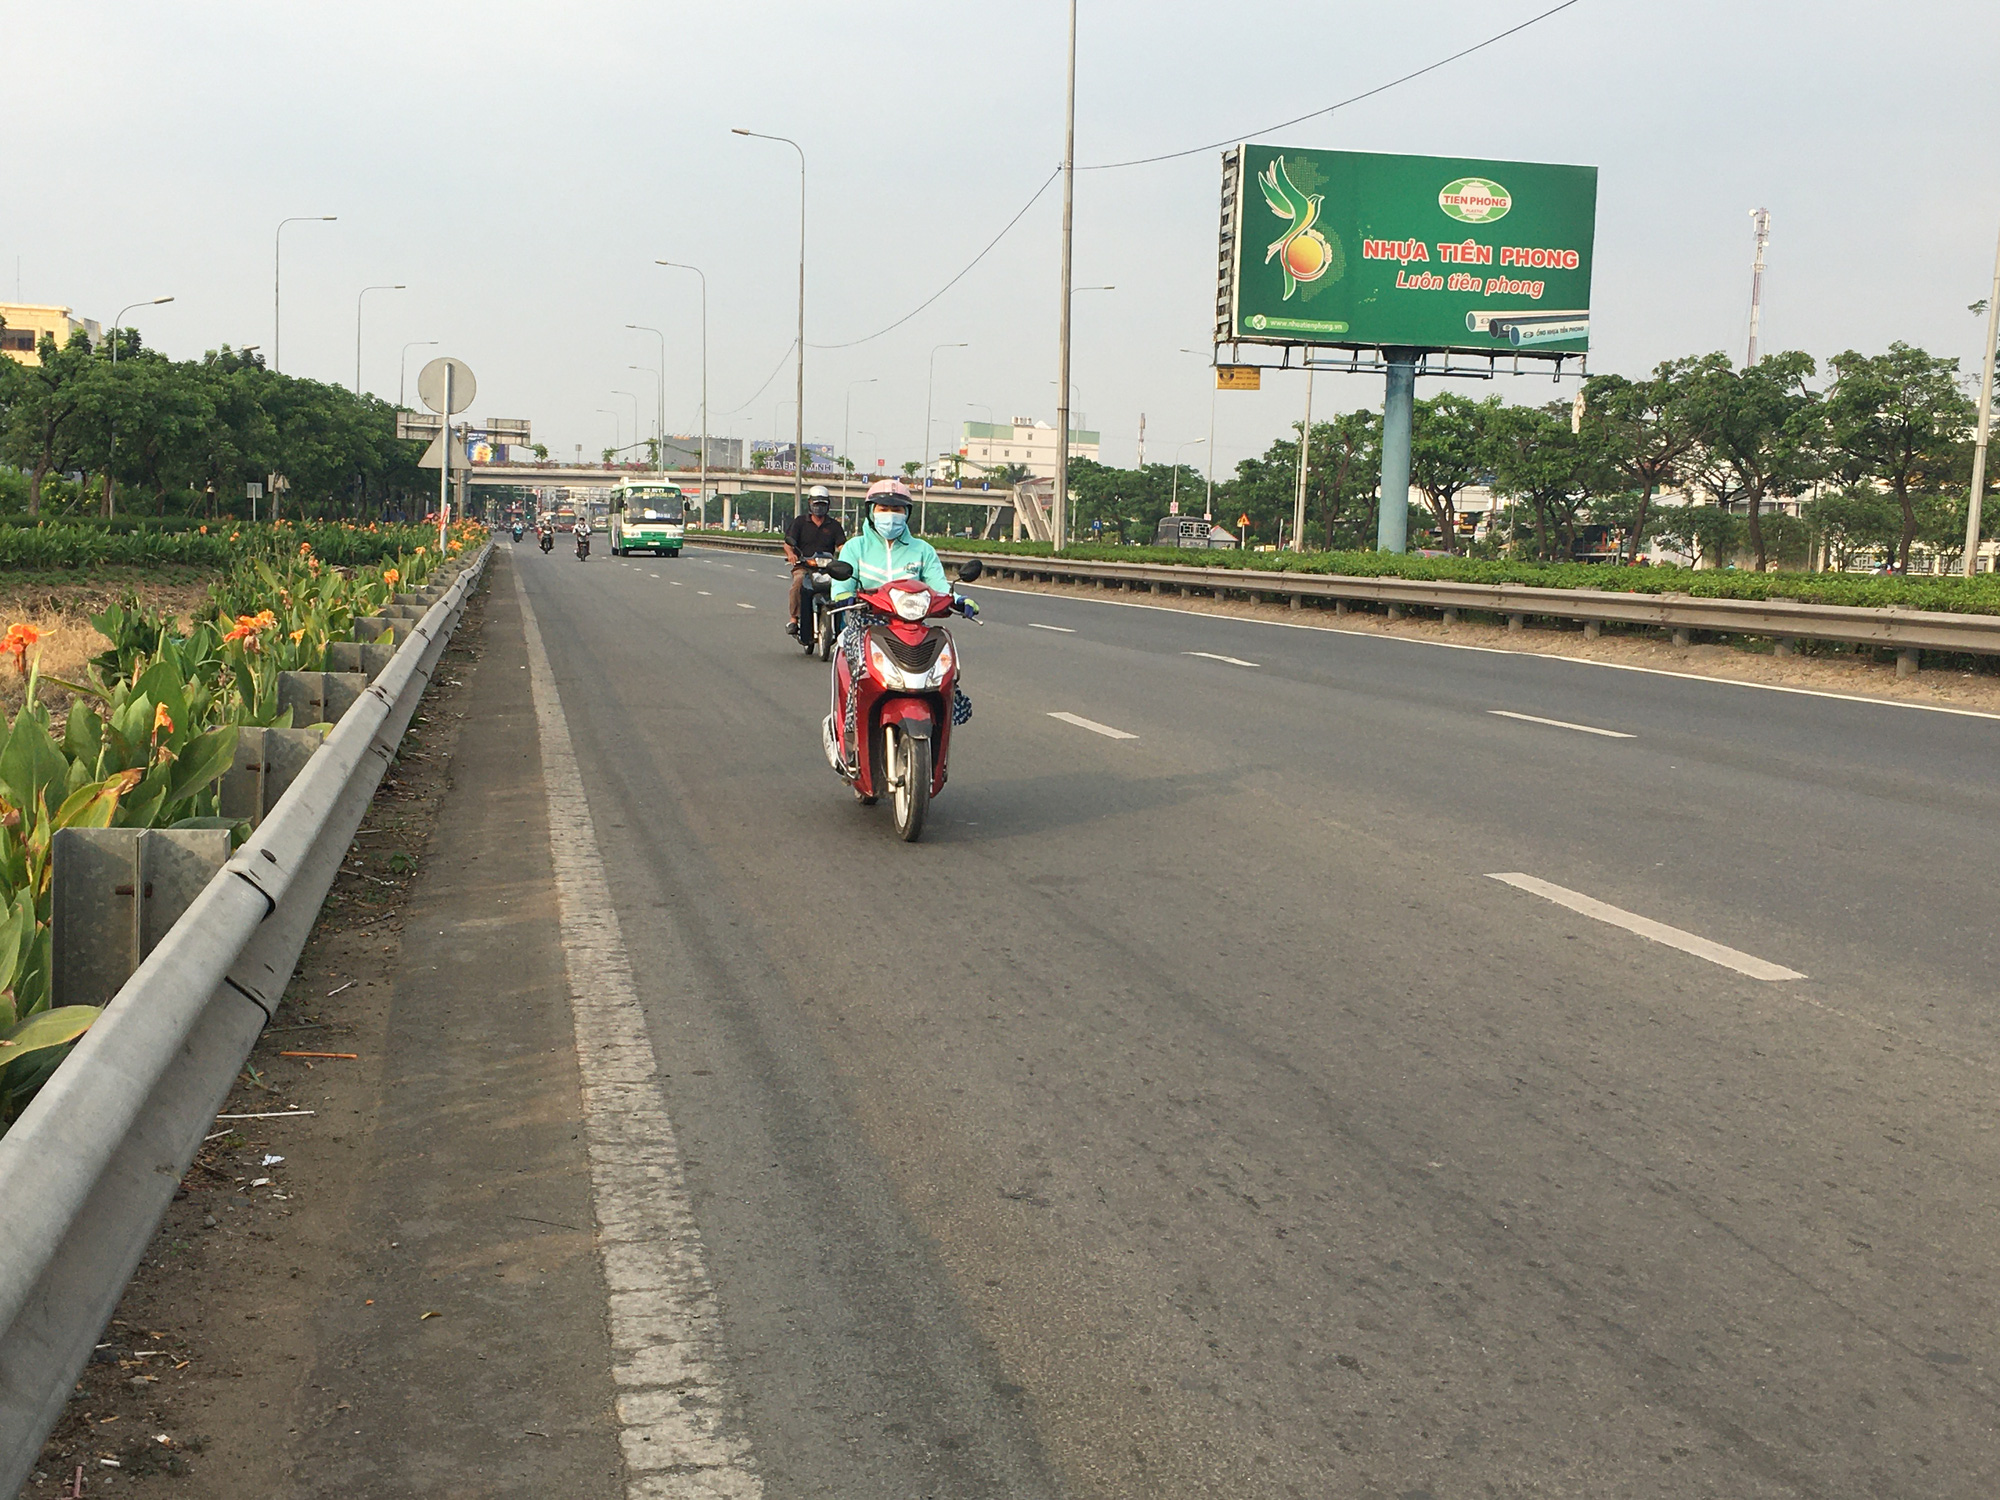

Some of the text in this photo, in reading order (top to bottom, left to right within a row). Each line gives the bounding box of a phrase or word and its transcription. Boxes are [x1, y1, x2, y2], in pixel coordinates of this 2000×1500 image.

[1444, 195, 1507, 207] TIEN PHONG
[1363, 238, 1580, 270] NHỰA TIỀN PHONG
[1396, 270, 1544, 299] Luôn tiên phong
